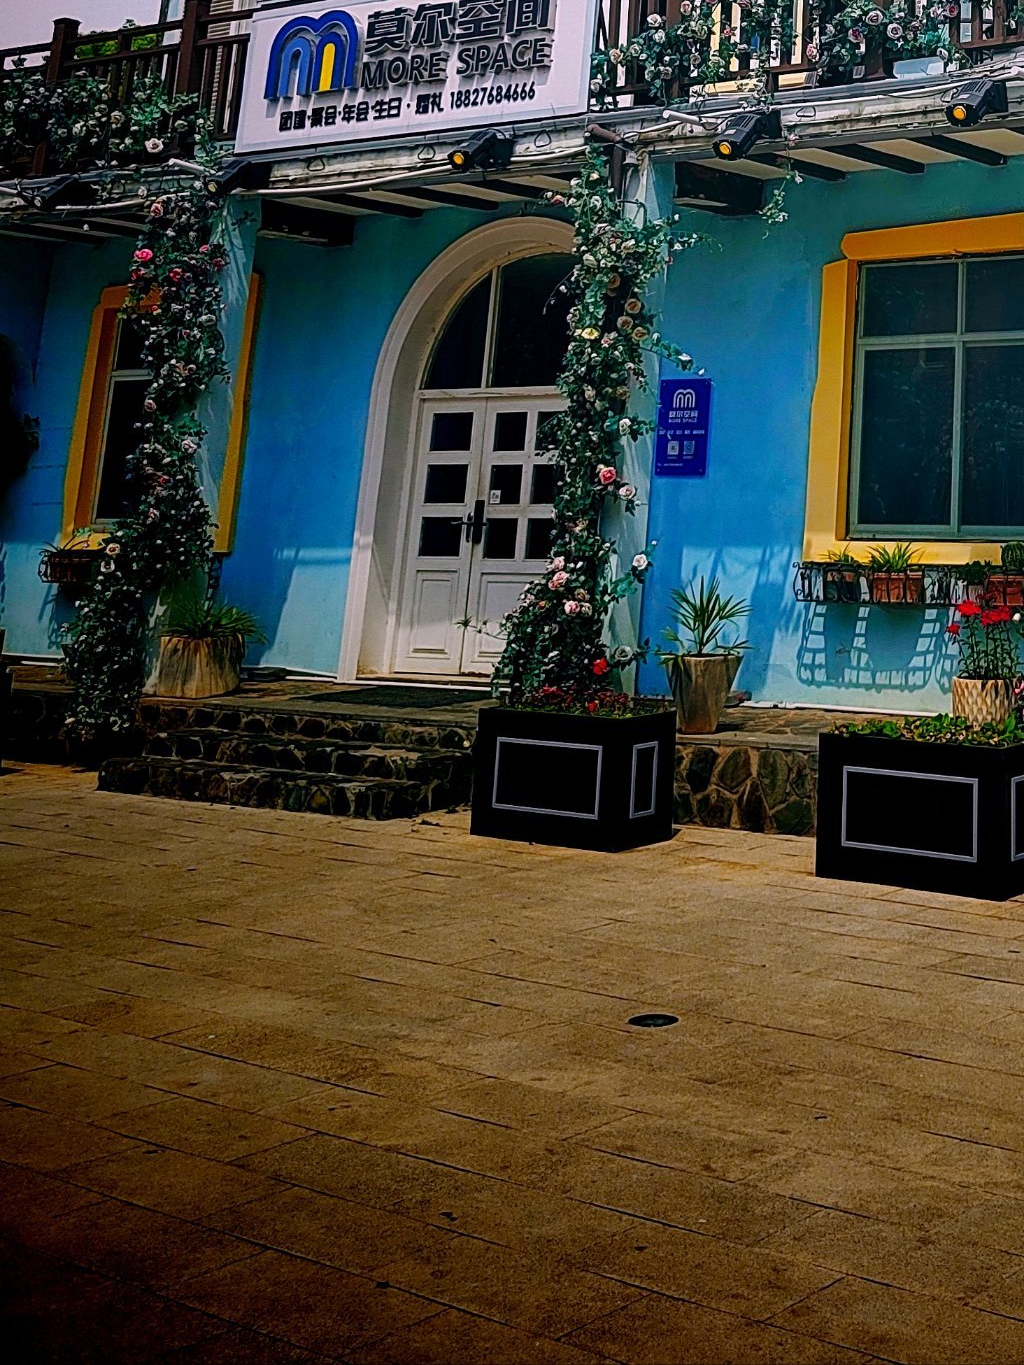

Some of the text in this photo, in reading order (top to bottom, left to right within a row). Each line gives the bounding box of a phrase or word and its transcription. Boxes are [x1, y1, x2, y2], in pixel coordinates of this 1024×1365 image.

[361, 37, 553, 89] MORE SPACE
[450, 81, 536, 110] 18827684666
